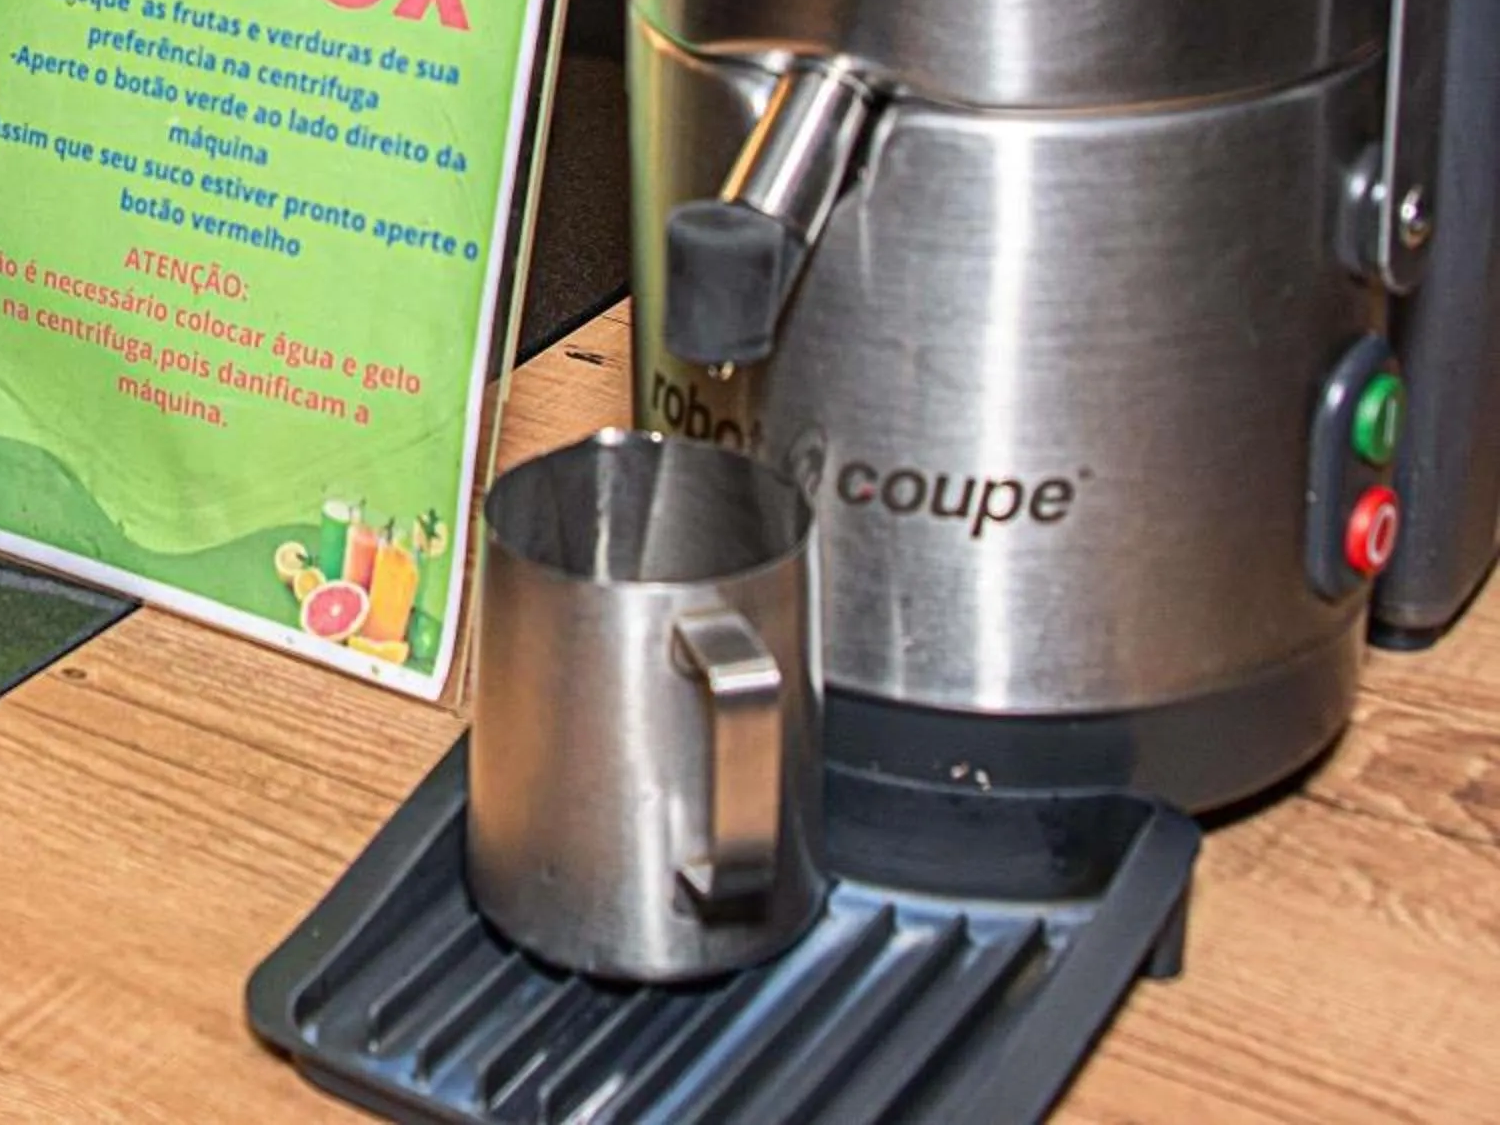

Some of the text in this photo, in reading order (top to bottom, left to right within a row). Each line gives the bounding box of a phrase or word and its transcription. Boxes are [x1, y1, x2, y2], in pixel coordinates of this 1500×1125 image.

[88, 28, 216, 71] preferência
[223, 59, 250, 79] na
[142, 0, 165, 20] as
[173, 1, 240, 36] frutas
[247, 23, 260, 40] e
[268, 29, 372, 65] verduras
[380, 49, 408, 73] de
[417, 60, 459, 85] sua
[94, 68, 108, 85] o
[114, 67, 178, 102] botão
[185, 91, 248, 119] verde
[254, 107, 282, 127] ao
[289, 109, 338, 141] lado
[345, 126, 429, 163] direito
[436, 146, 467, 172] da
[169, 127, 268, 165] máquina
[54, 137, 93, 161] que
[100, 149, 137, 173] seu
[143, 160, 194, 186] suco
[201, 175, 278, 207] estiver
[284, 197, 365, 232] pronto
[373, 220, 457, 255] aperte
[463, 242, 479, 261] o
[120, 188, 300, 256] botão vermelho
[4, 300, 30, 322] na
[218, 361, 347, 415] danificam
[355, 406, 369, 425] a
[24, 260, 37, 283] é
[44, 273, 168, 321] necessário
[176, 308, 263, 347] colocar
[272, 335, 335, 369] água
[343, 357, 357, 376] e
[362, 365, 421, 393] gelo
[118, 376, 228, 428] máquina.
[836, 461, 1077, 538] coupe
